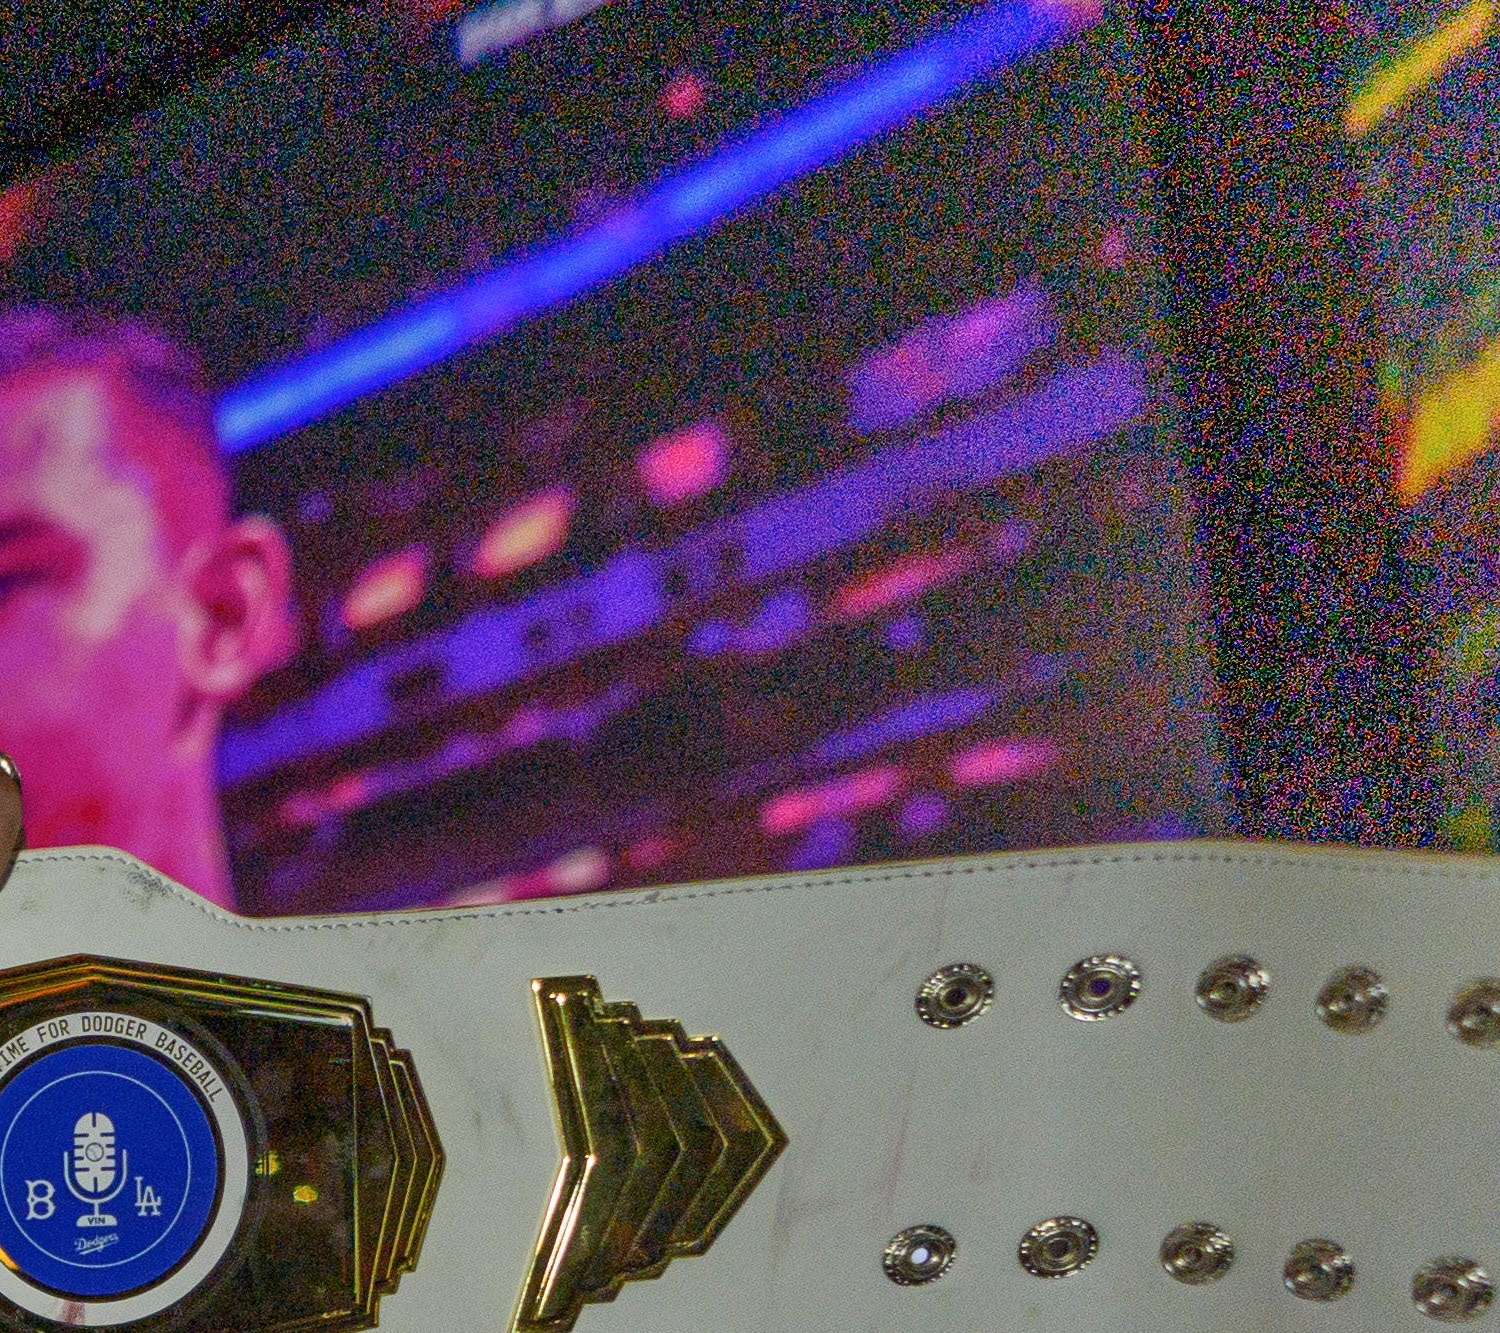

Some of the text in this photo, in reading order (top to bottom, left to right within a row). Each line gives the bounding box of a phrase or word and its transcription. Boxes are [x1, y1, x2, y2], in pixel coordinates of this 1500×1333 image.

[36, 1018, 70, 1044] FOR
[81, 1014, 148, 1042] DODGER
[154, 1031, 225, 1103] BASEBALL
[134, 1176, 162, 1217] LA
